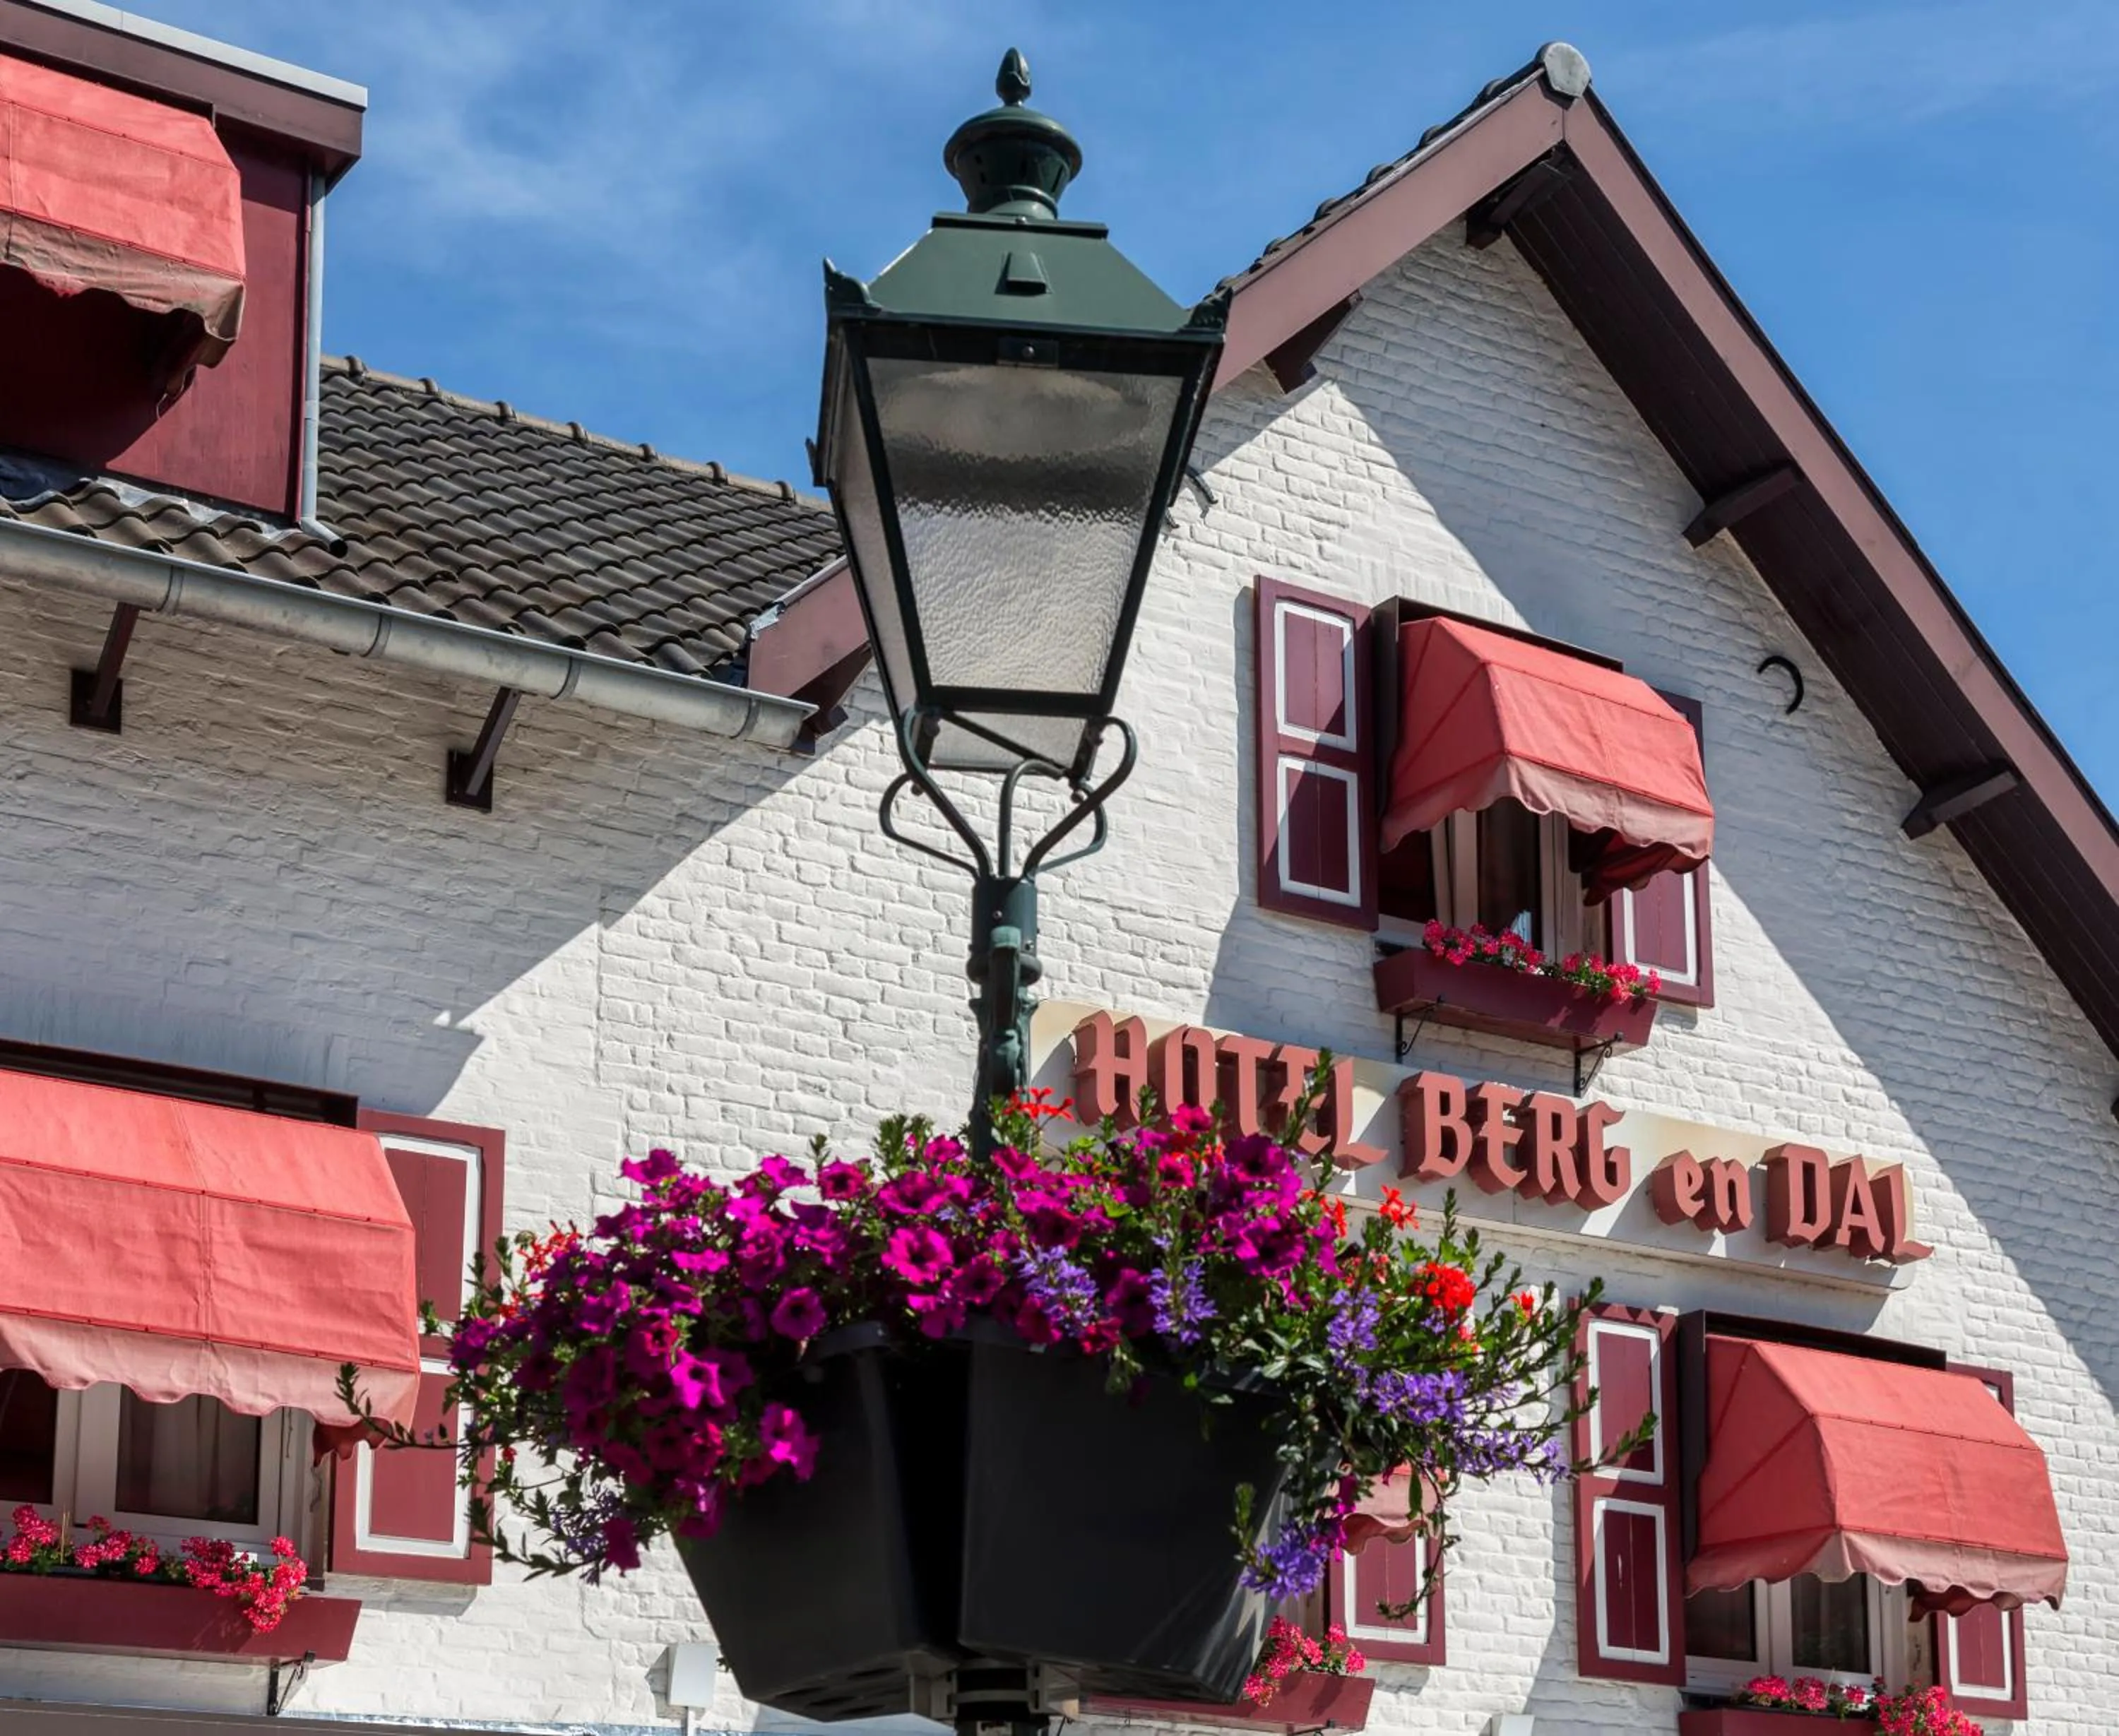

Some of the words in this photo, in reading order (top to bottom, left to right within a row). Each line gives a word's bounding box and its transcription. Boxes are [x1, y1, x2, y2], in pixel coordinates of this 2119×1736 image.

[1073, 1010, 1389, 1170] HOTEL
[1396, 1071, 1630, 1211] BERG
[1649, 1149, 1754, 1233] en
[1761, 1143, 1934, 1265] DAL
